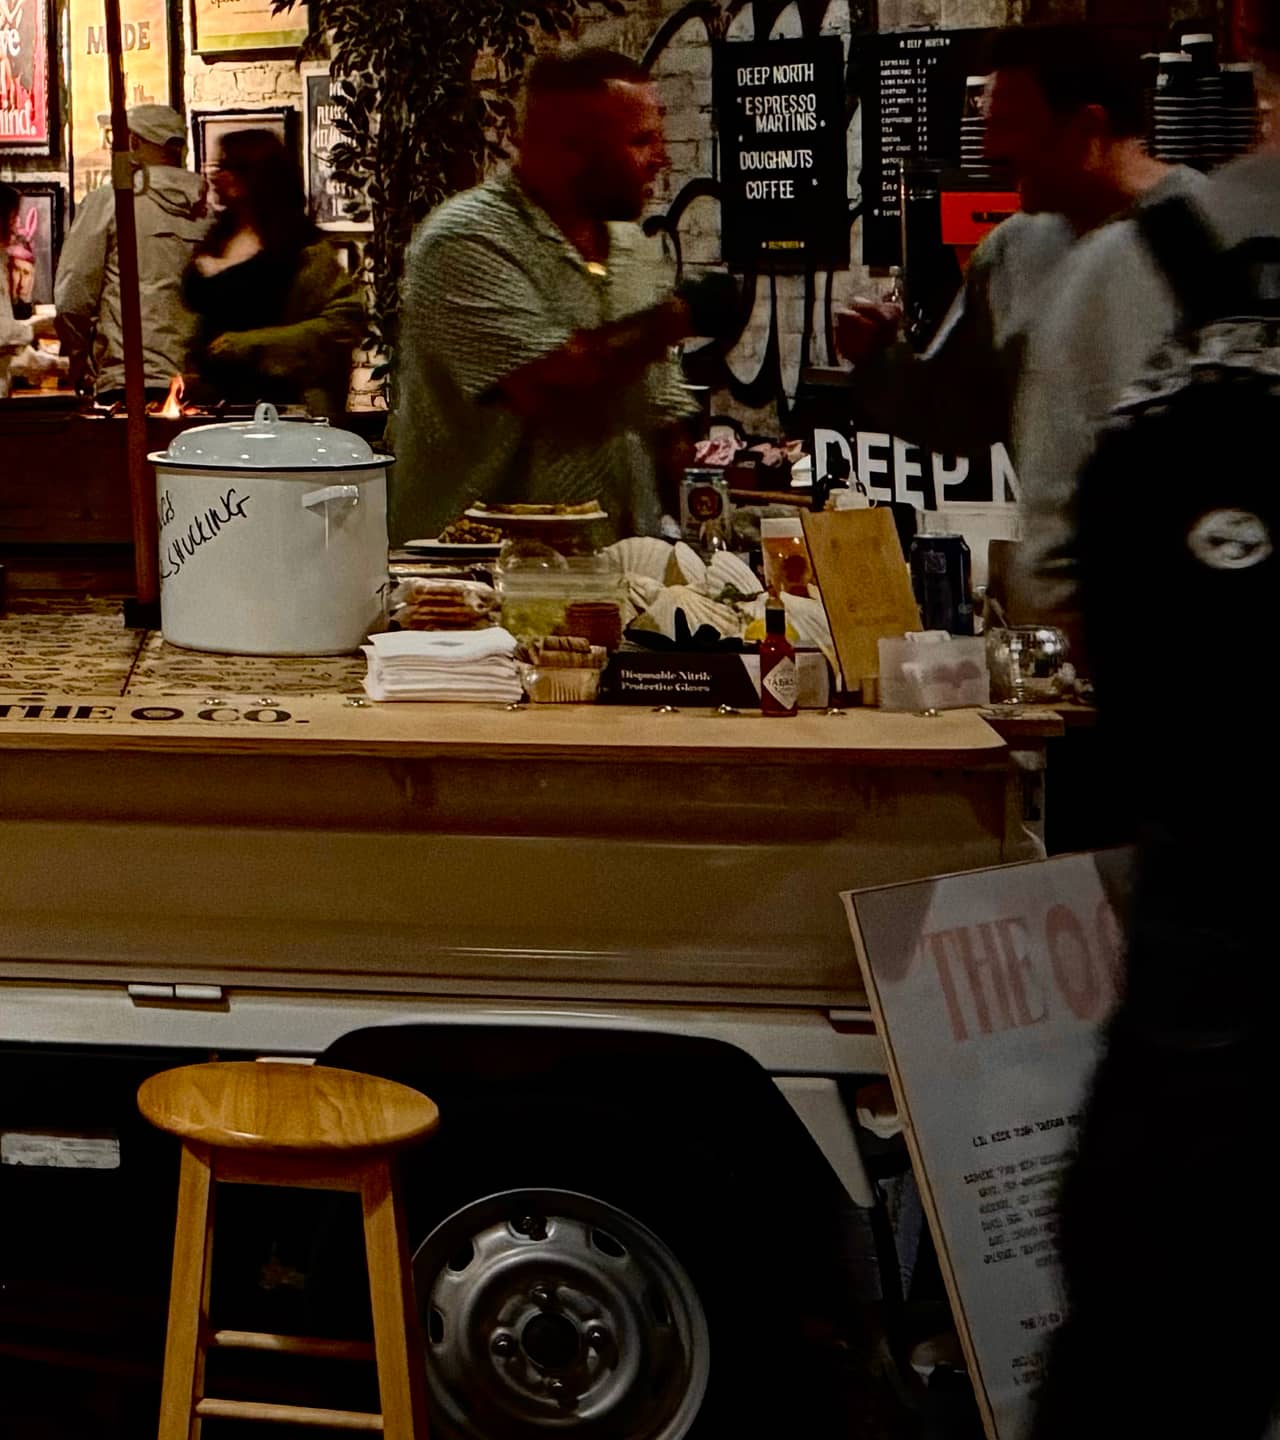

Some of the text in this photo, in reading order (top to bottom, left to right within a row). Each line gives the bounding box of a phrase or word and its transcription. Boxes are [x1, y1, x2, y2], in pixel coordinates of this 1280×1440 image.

[87, 21, 151, 56] MDE
[737, 63, 814, 86] DEEP NORTH
[745, 93, 816, 115] ESPRESSO
[756, 112, 817, 134] MARTINIS
[739, 149, 813, 170] DOUGHNUTS
[746, 180, 795, 199] COFFEE
[197, 707, 310, 724] CO.
[922, 917, 1049, 1041] THE
